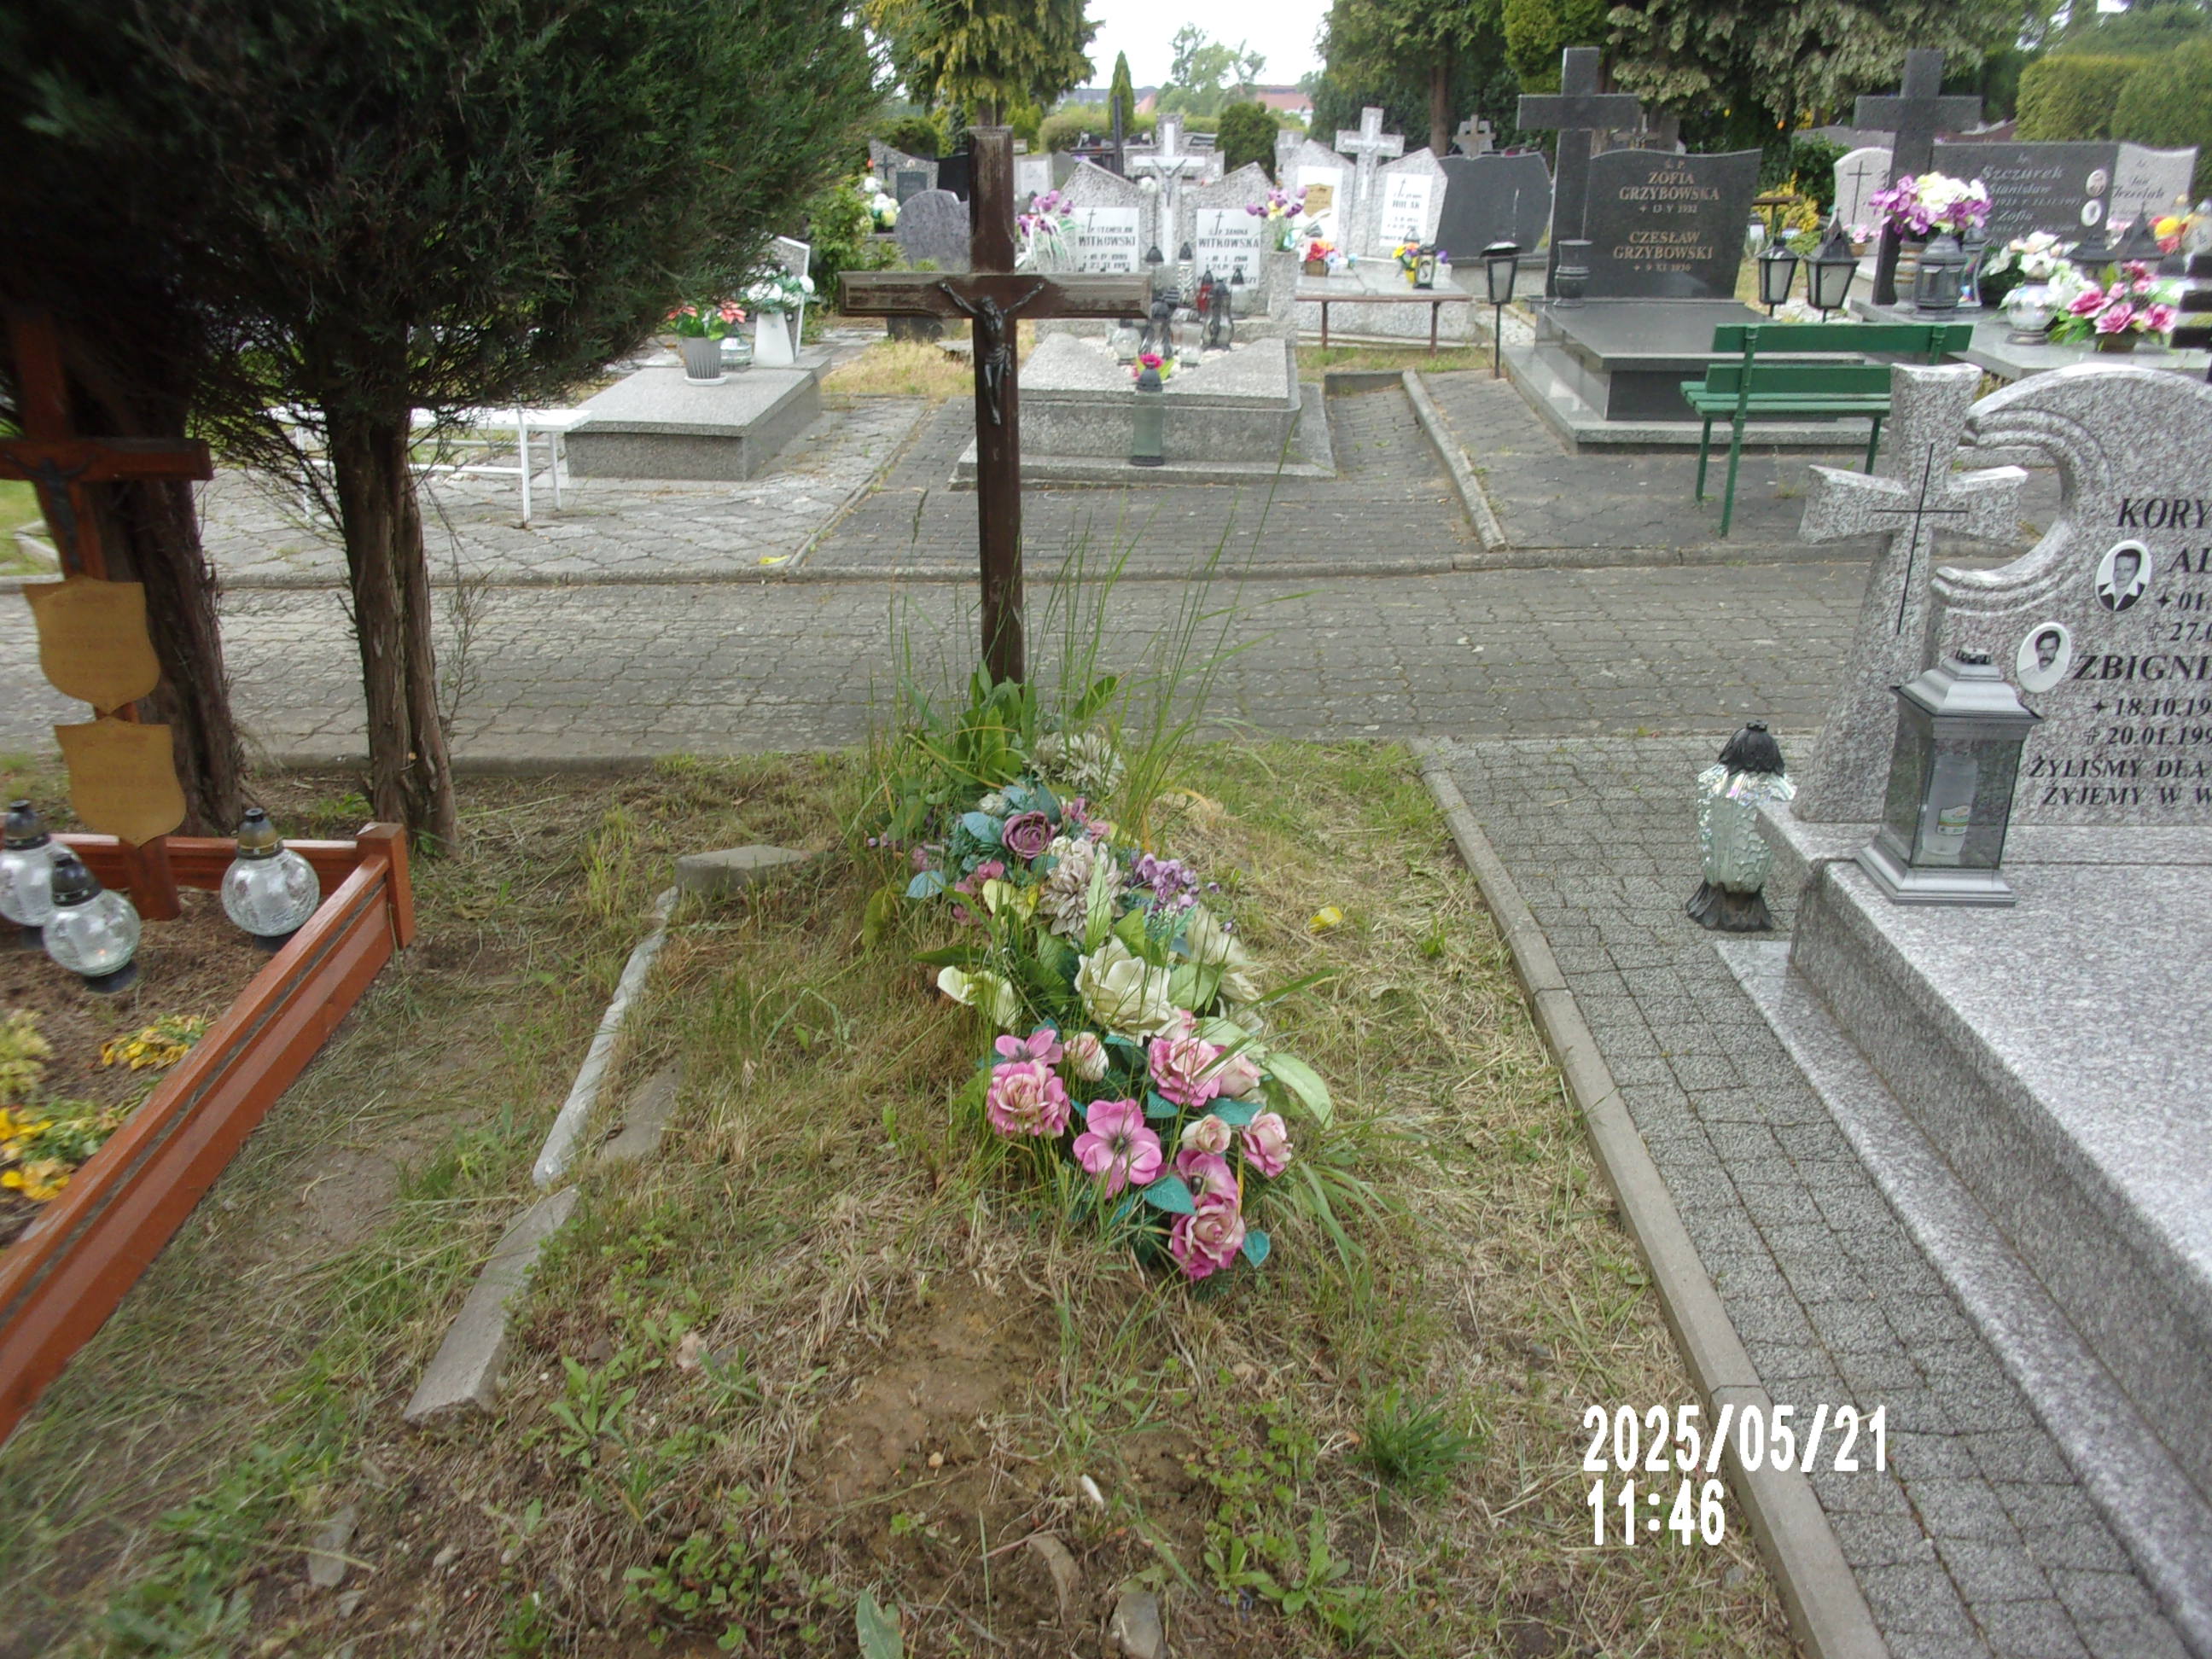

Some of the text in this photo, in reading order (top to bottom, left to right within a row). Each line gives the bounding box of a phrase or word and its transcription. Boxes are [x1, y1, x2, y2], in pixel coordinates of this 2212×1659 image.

[1648, 171, 1695, 184] ZOFIA
[1982, 165, 2064, 180] Szczurek
[1619, 186, 1720, 201] GRZYBOWSKA
[1997, 209, 2034, 223] Zofia
[1079, 236, 1136, 247] WITKOWSKI
[1198, 238, 1260, 248] WITKOWSKA
[1629, 231, 1701, 244] CZESŁAW
[1613, 246, 1714, 259] GRZYBOWSKI
[2116, 498, 2212, 529] KORY
[2029, 754, 2145, 778] ŻYLIŚMY
[2156, 759, 2205, 778] DLA
[2041, 780, 2146, 806] ŻYJEMY
[2159, 786, 2182, 806] W
